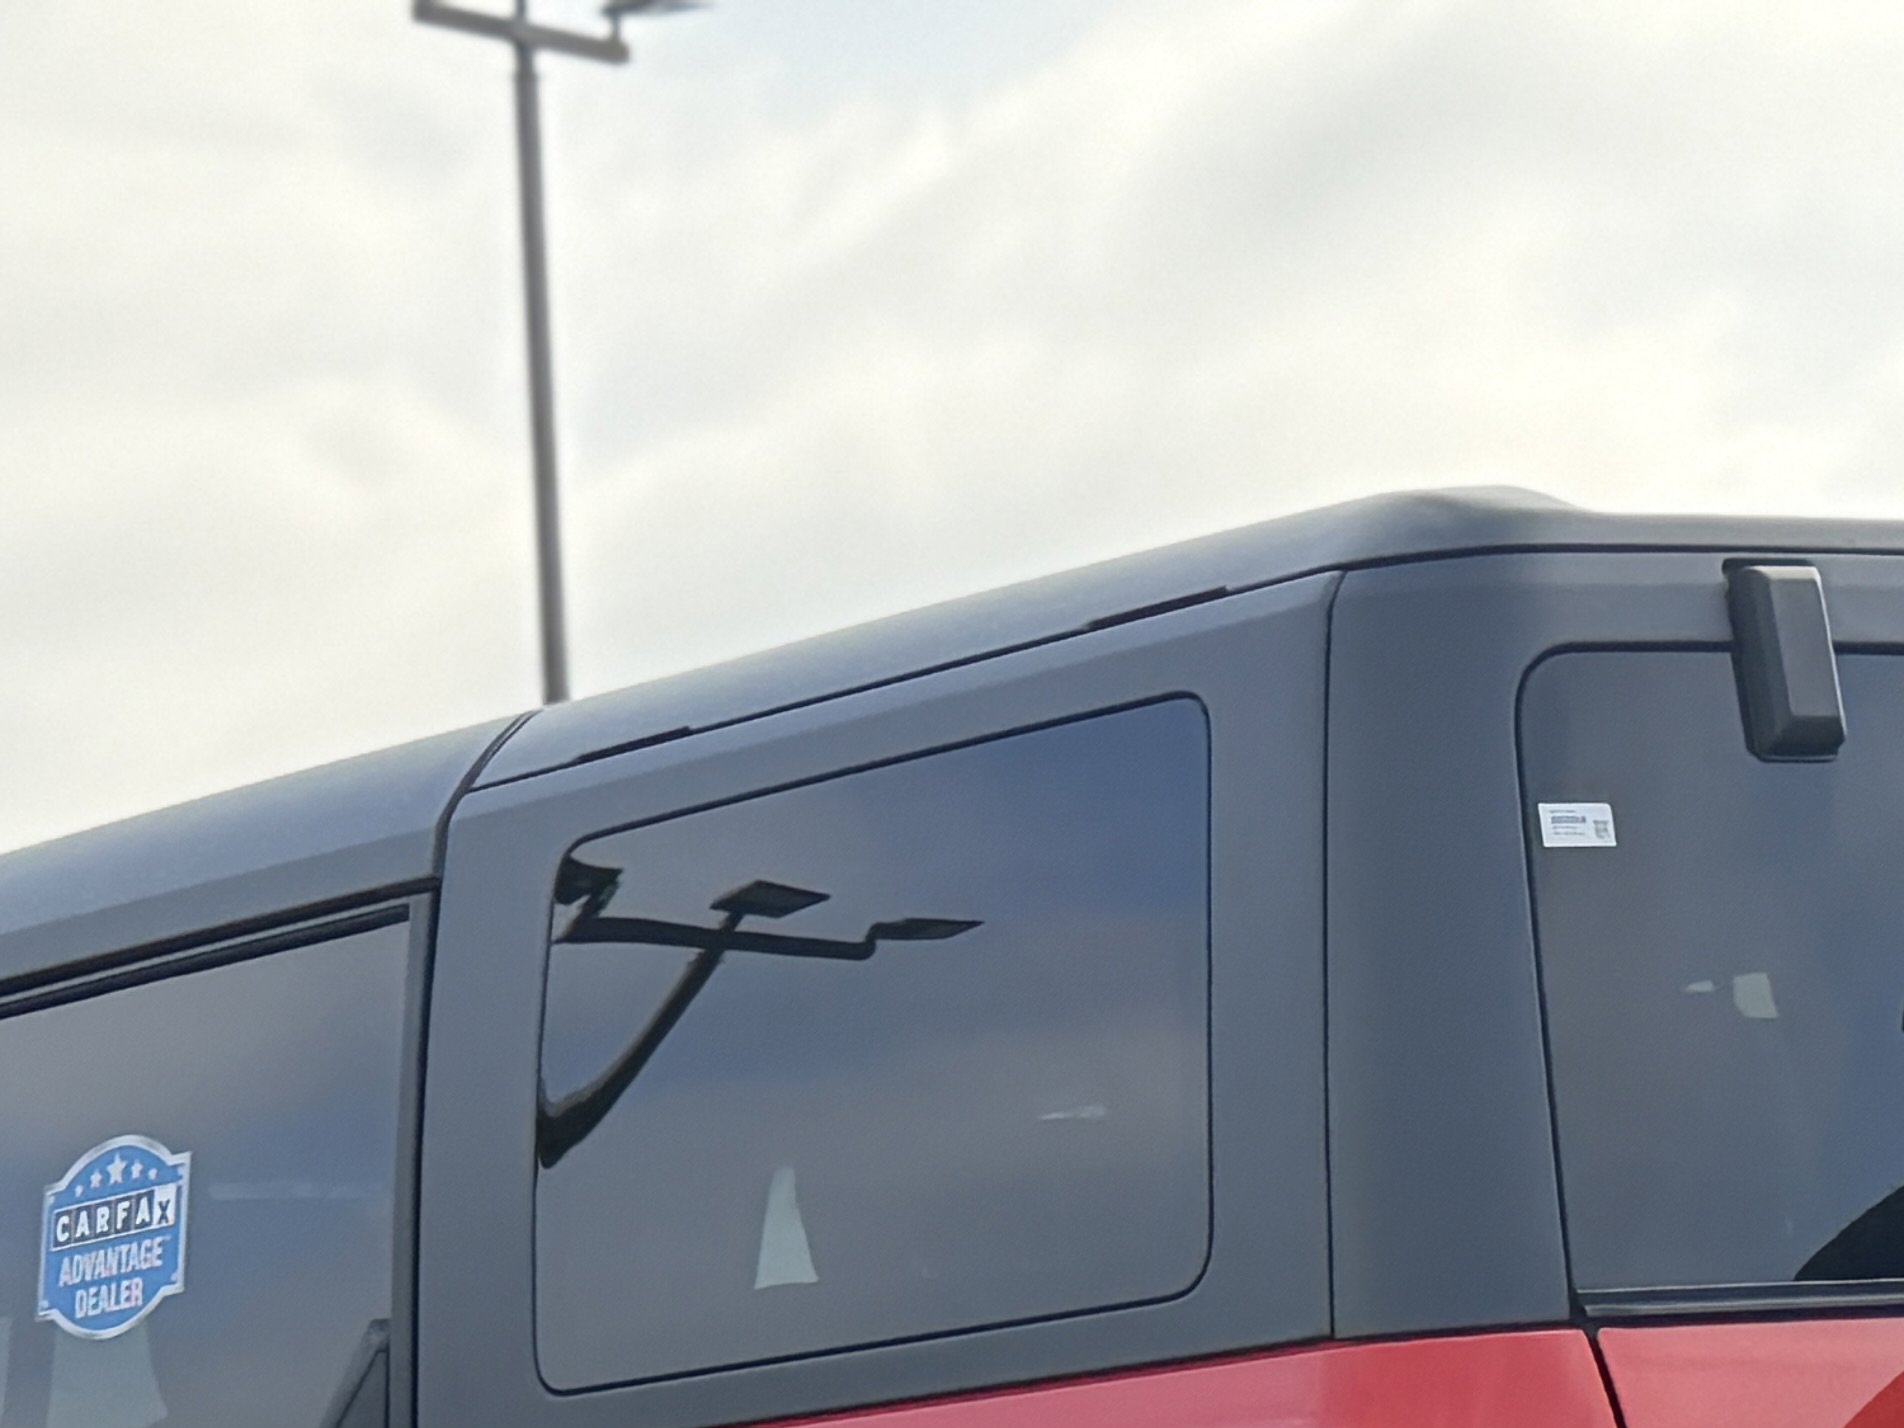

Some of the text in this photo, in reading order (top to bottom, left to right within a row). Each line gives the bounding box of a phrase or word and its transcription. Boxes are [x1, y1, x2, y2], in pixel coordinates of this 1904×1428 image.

[56, 1197, 172, 1242] CARFAX
[59, 1238, 164, 1288] ADVANTAGE
[75, 1277, 144, 1319] DEALER
